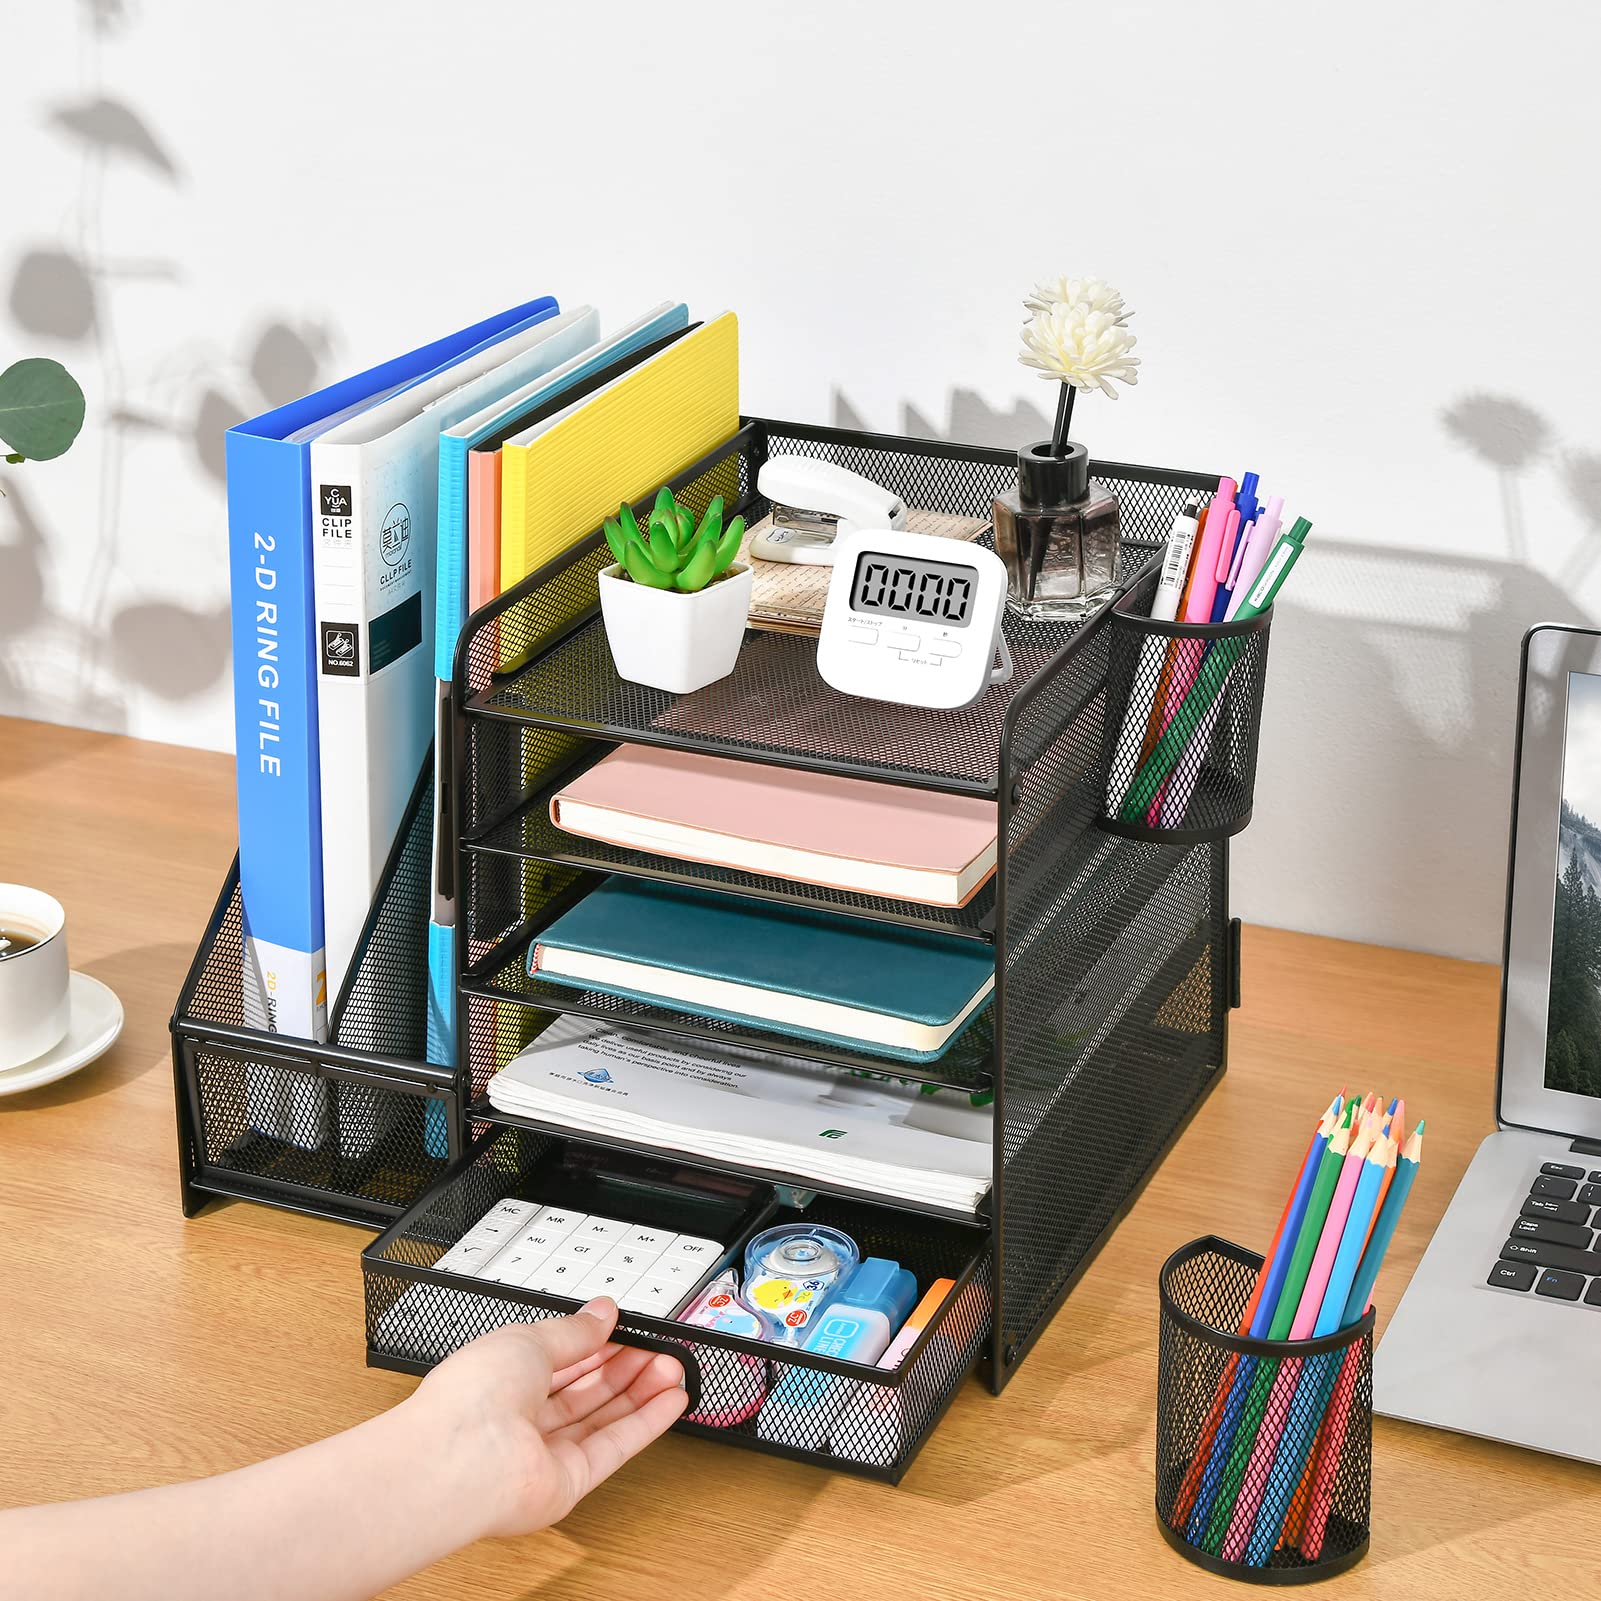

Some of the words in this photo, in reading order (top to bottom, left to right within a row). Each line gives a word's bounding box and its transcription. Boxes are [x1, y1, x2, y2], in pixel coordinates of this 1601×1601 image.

[322, 517, 352, 528] CLIP
[322, 528, 352, 538] FILE
[254, 531, 276, 591] 2-D
[398, 559, 412, 575] FILE
[256, 600, 279, 690] RING
[258, 699, 281, 777] FILE
[595, 1027, 619, 1039] Clean,
[621, 1036, 670, 1053] comfortable,
[689, 1053, 723, 1065] cheerful
[722, 1061, 742, 1069] lives
[577, 1044, 600, 1054] taking
[600, 1050, 631, 1063] human's
[631, 1060, 674, 1074] perspective
[674, 1070, 689, 1078] into
[582, 1039, 601, 1047] daily
[600, 1044, 617, 1052] lives
[641, 1055, 660, 1064] basis
[660, 1061, 681, 1069] point
[707, 1072, 732, 1081] always
[600, 1038, 625, 1048] deliver
[625, 1045, 648, 1055] useful
[647, 1051, 680, 1063] products
[691, 1062, 733, 1076] considering
[500, 1206, 521, 1215] MC
[545, 1215, 566, 1224] MR
[1520, 1220, 1539, 1228] Caps
[1518, 1224, 1537, 1232] Lock
[527, 1236, 547, 1245] MU
[636, 1235, 656, 1243] M+
[573, 1245, 591, 1254] GT
[682, 1244, 705, 1253] OFF
[1519, 1246, 1538, 1255] Shift
[511, 1256, 522, 1264] 7
[622, 1255, 634, 1264] %
[556, 1266, 567, 1274] 8
[1500, 1269, 1517, 1278] Ctrl
[605, 1276, 615, 1284] 9
[1545, 1276, 1558, 1284] Fn
